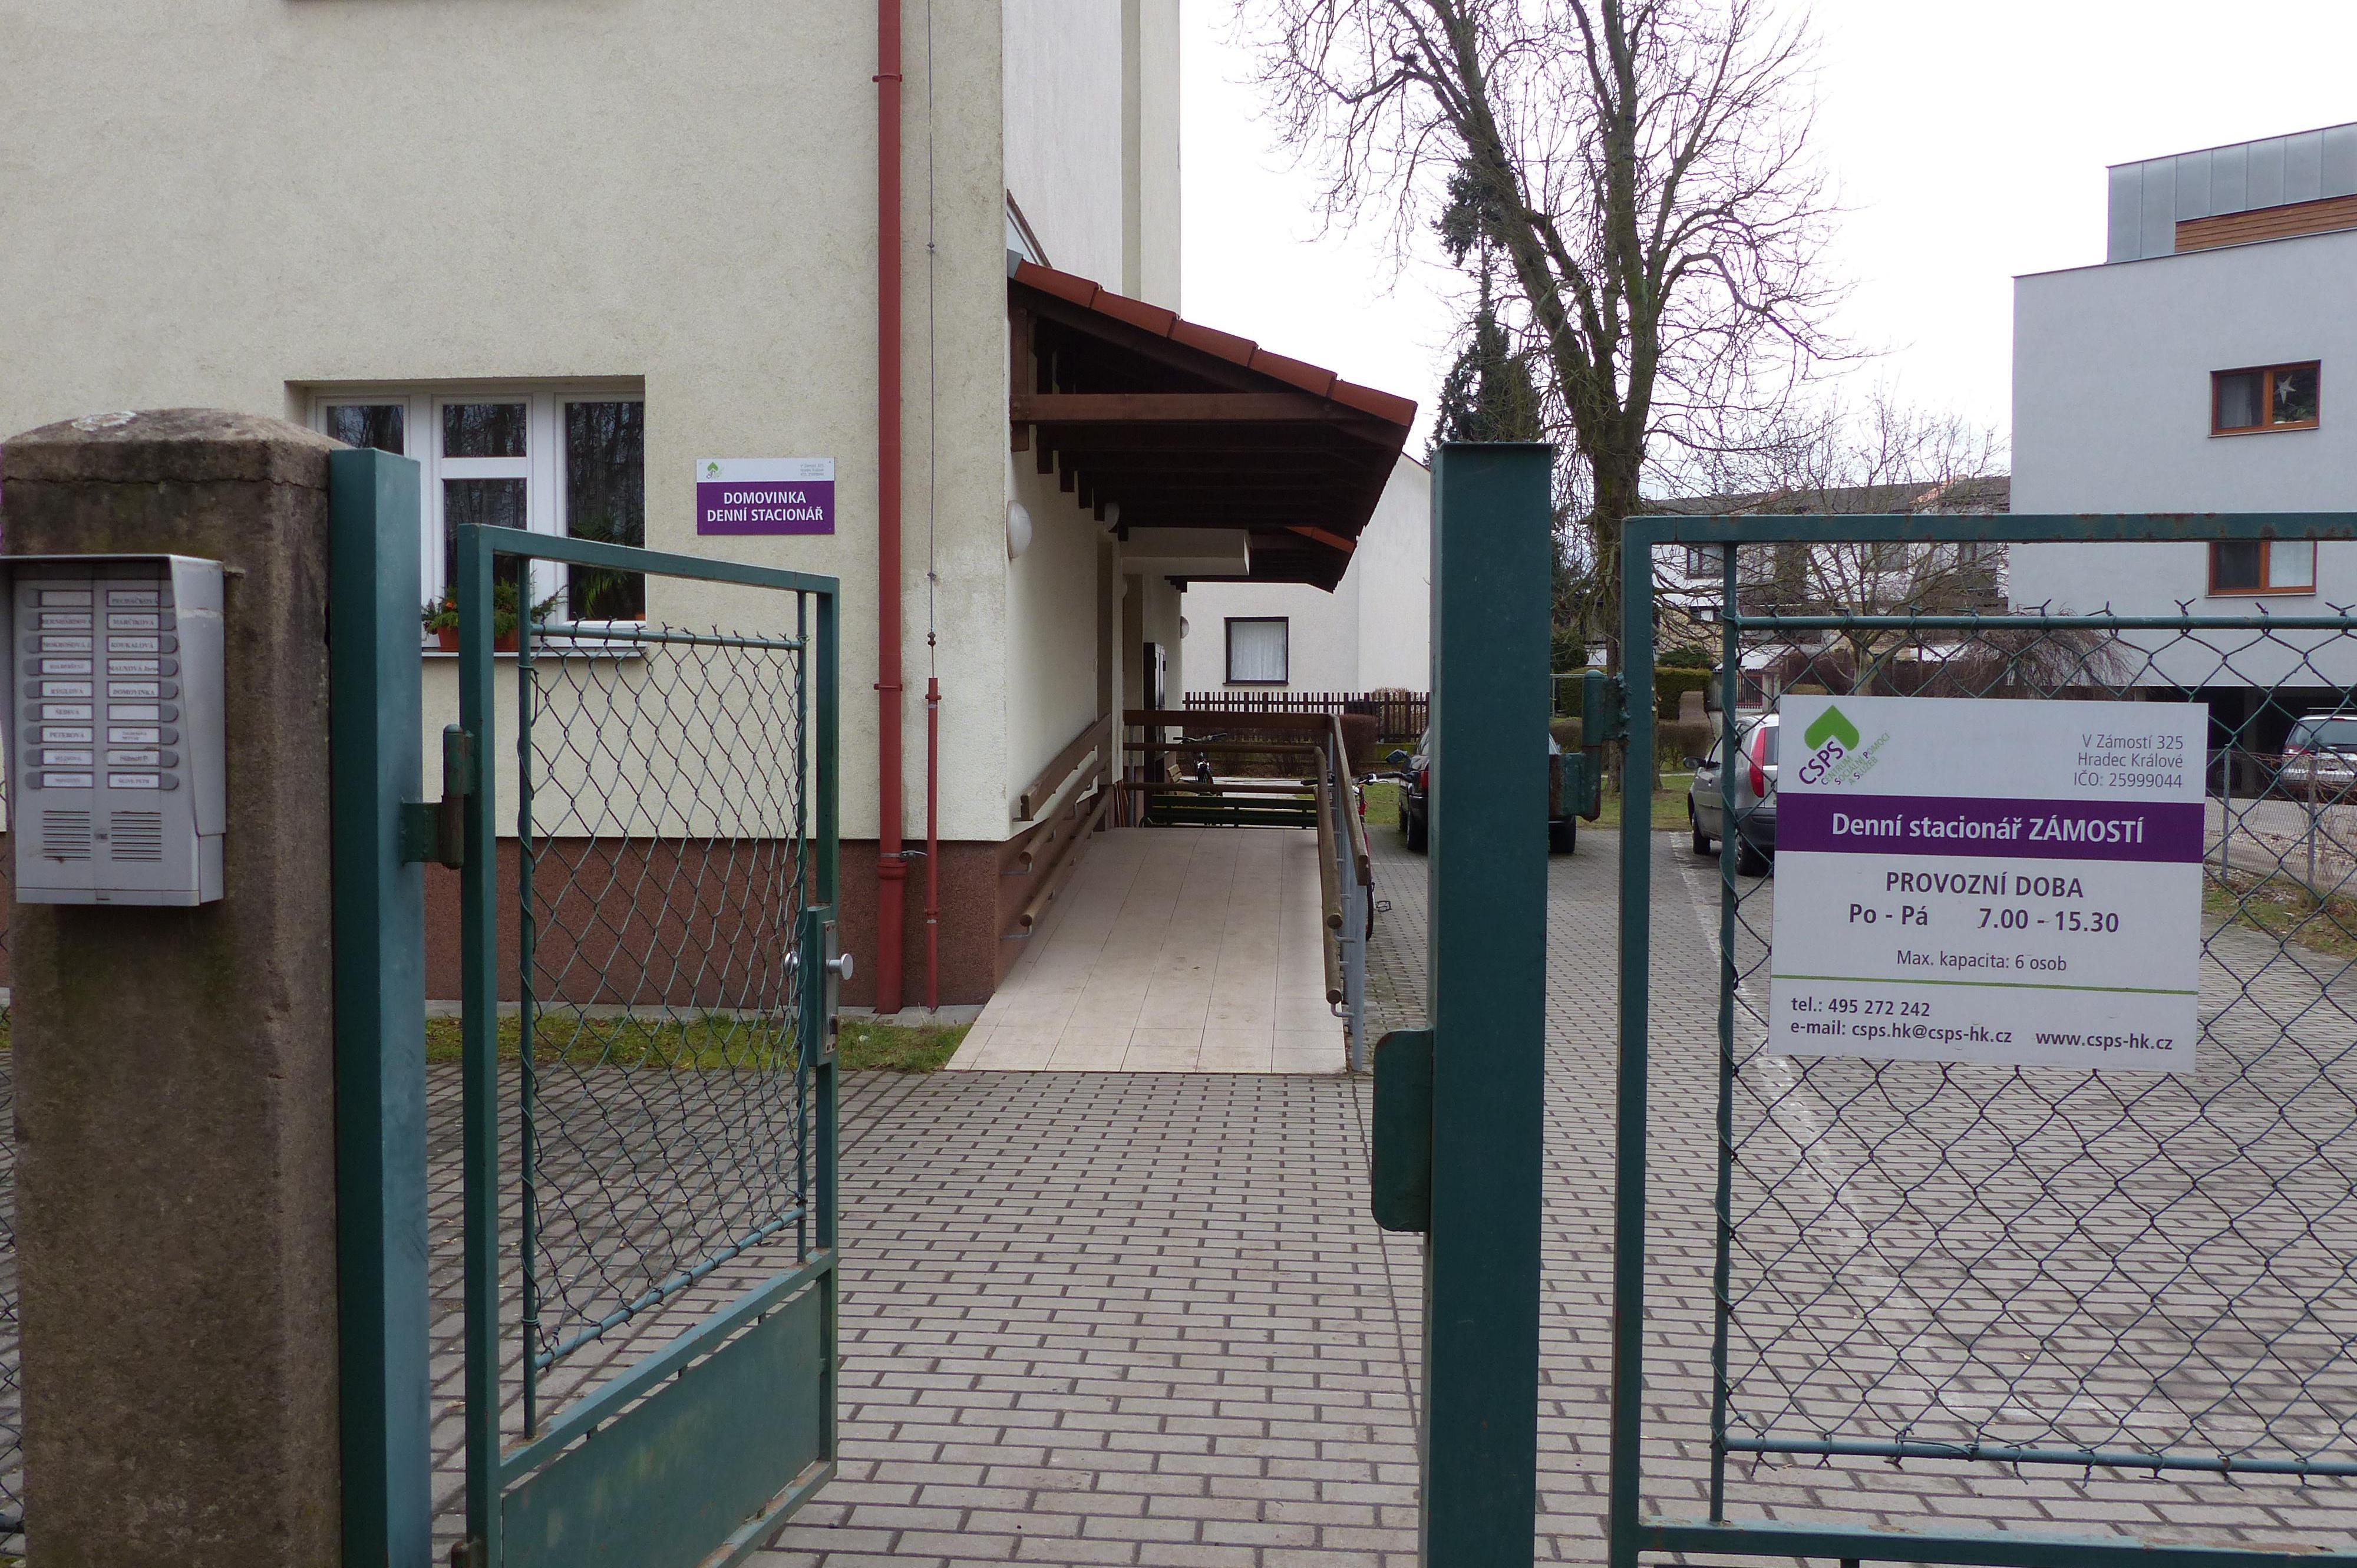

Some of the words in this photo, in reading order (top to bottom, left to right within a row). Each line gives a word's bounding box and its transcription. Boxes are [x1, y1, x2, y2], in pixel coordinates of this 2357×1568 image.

[724, 491, 807, 504] DOMOVINKA
[707, 507, 748, 521] DENNÍ
[751, 506, 823, 521] STACIONÁŘ
[1862, 732, 1890, 759] POMOCI
[2082, 734, 2092, 748] V
[2097, 734, 2153, 749] Zámostí
[2157, 735, 2184, 750] 325
[1798, 740, 1844, 785] CSPS
[1821, 755, 1853, 785] CENTRUM
[2078, 751, 2127, 767] Hradec
[2131, 752, 2183, 768] Králové
[2074, 769, 2104, 787] IČO:
[2108, 773, 2183, 788] 25999044
[1832, 813, 1903, 837] Denní
[1909, 816, 2022, 840] stacionář
[2029, 814, 2144, 843] ZÁMOSTÍ
[1886, 871, 2008, 896] PROVOZNÍ
[2016, 876, 2084, 898] DOBA
[1849, 903, 1877, 924] Po
[1902, 905, 1928, 926] Pá
[1979, 907, 2029, 929] 7.00
[2055, 910, 2120, 933] 15.30
[1897, 950, 1934, 966] Max.
[1940, 950, 2009, 970] kapacita:
[2015, 954, 2025, 969] 6
[2029, 955, 2067, 971] osob
[1791, 996, 1823, 1012] tel.:
[1828, 998, 1858, 1014] 495
[1864, 1000, 1894, 1015] 272
[1900, 1001, 1930, 1017] 242
[1790, 1020, 1846, 1035] e-mail:
[1851, 1022, 2012, 1044] csps.hk@csps-hk.cz
[2035, 1032, 2173, 1051] www.csps-hk.cz
